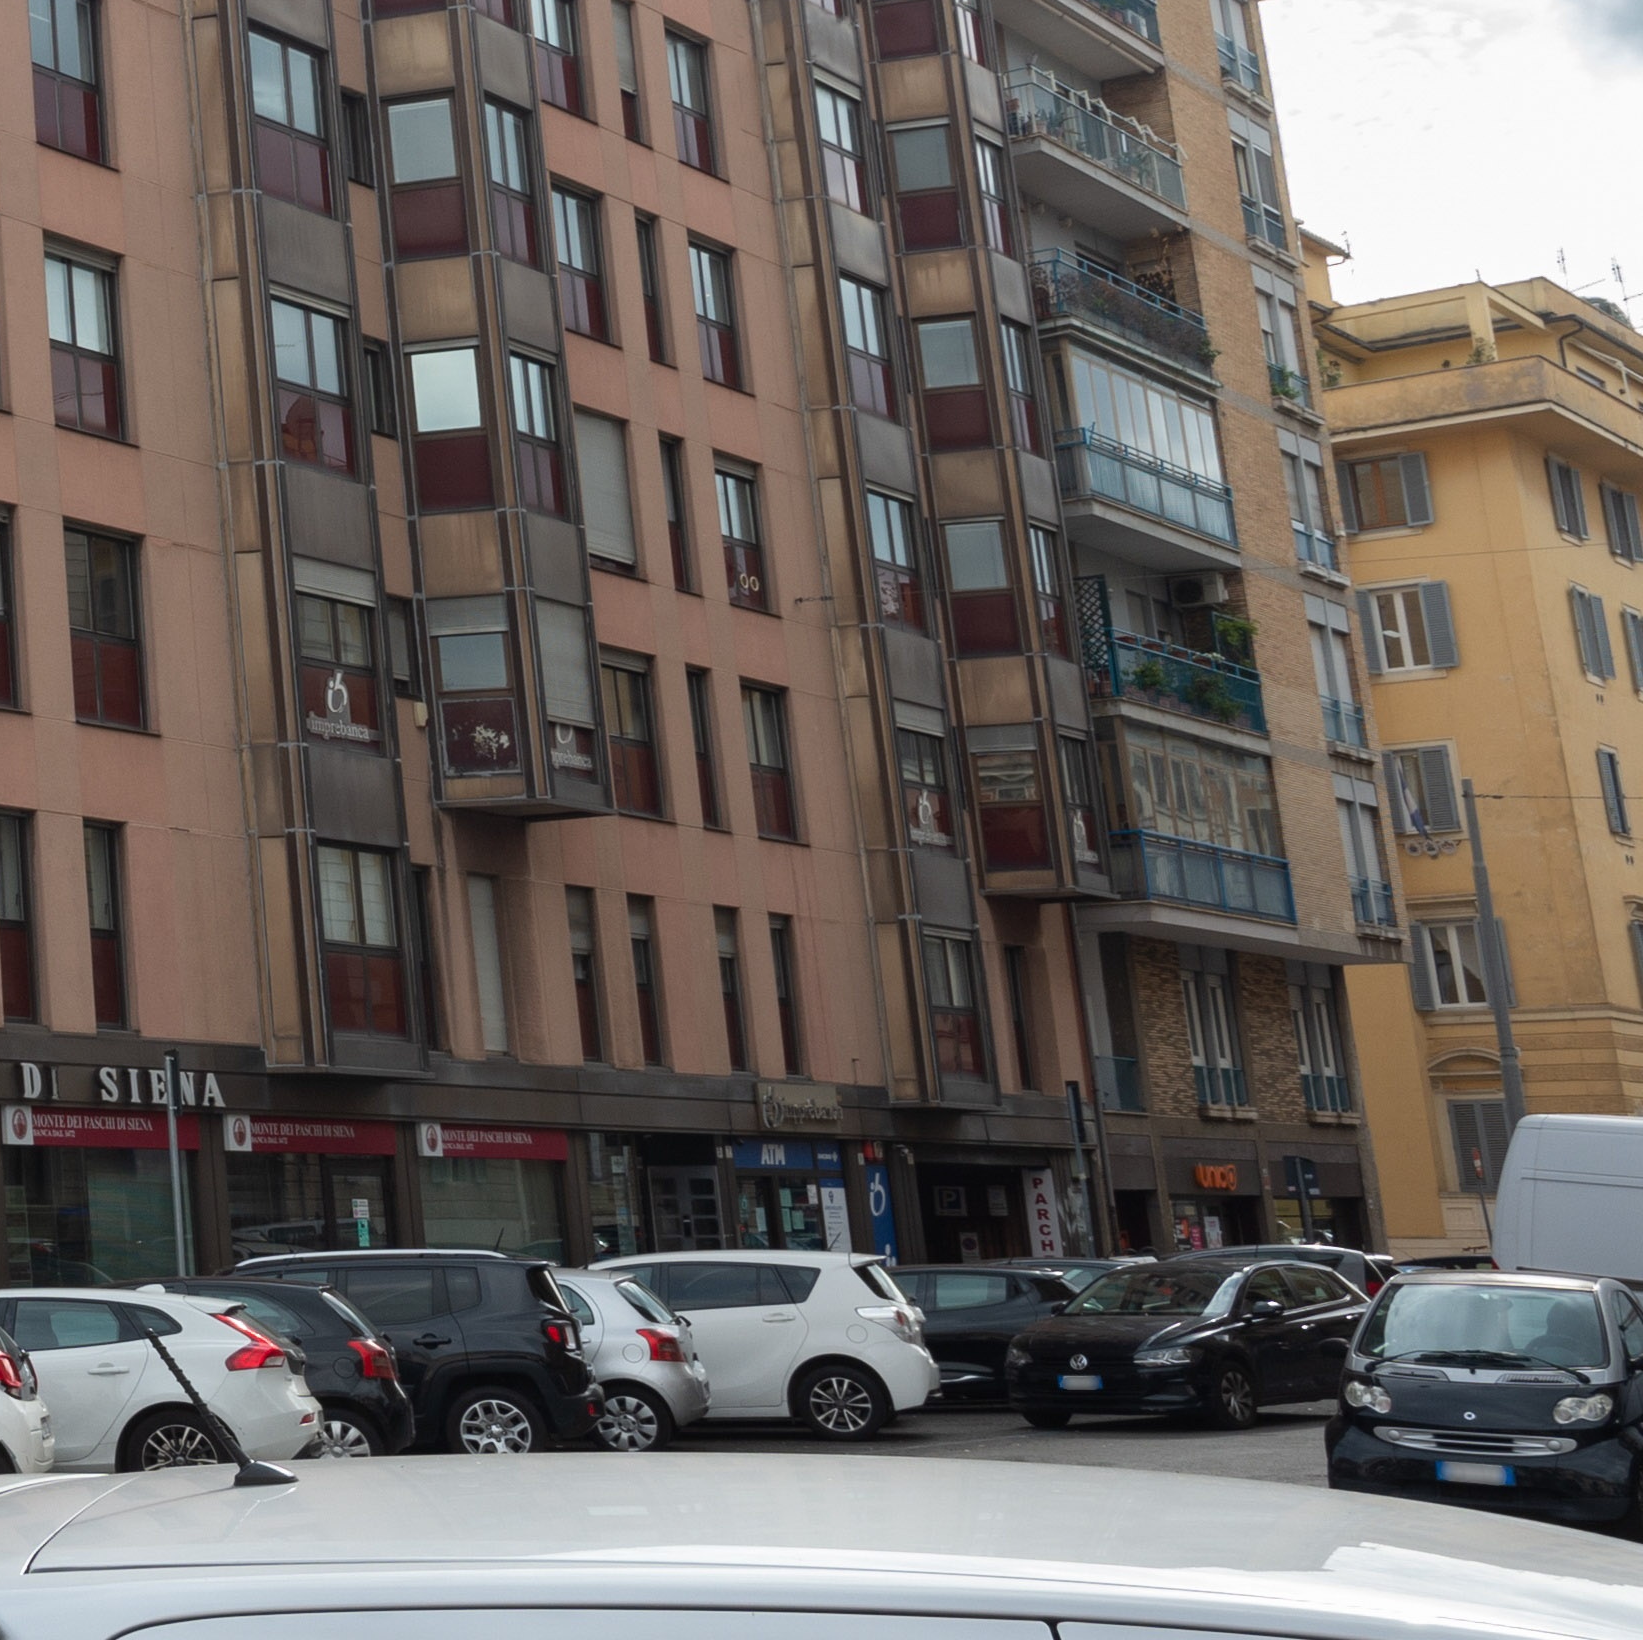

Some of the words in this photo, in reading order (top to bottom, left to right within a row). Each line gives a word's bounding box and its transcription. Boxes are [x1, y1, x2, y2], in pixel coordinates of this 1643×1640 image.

[99, 1066, 226, 1108] SIENA
[32, 1113, 66, 1128] MONTE
[66, 1115, 83, 1128] DEI
[84, 1115, 115, 1130] PASCHI
[116, 1117, 126, 1131] DI
[127, 1117, 153, 1132] SIENA
[761, 1143, 786, 1166] ATM
[1032, 1177, 1055, 1257] PARCH
